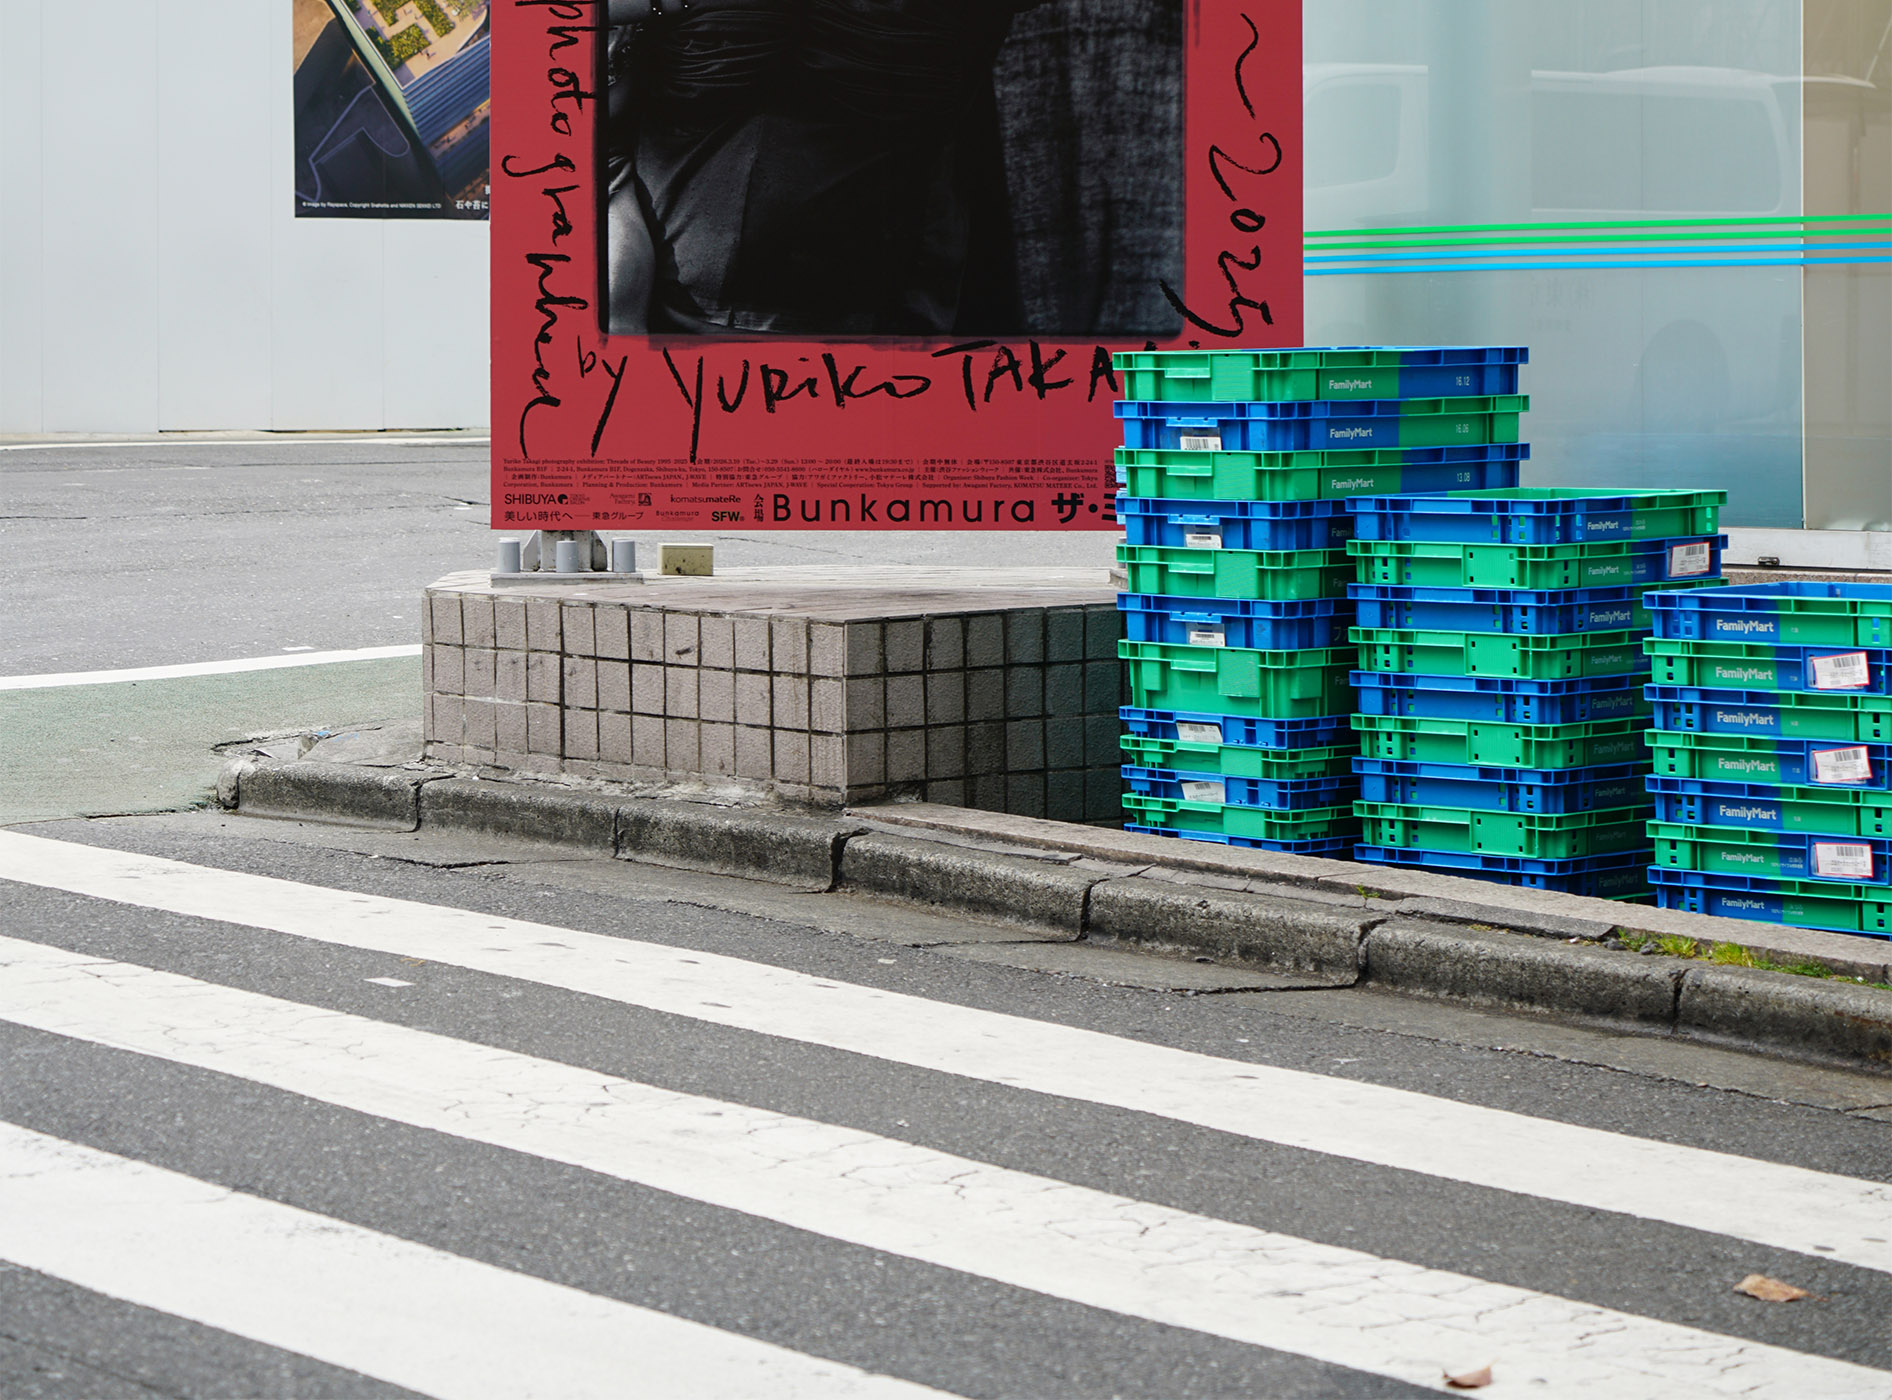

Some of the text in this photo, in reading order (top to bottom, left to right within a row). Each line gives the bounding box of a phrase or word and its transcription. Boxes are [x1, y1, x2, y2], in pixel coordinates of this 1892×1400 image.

[1329, 379, 1372, 391] FamilyMart
[577, 335, 628, 458] by
[1330, 428, 1373, 440] FamilyMart
[1332, 478, 1374, 491] FamilyMart
[504, 493, 557, 505] SHIBUYA
[773, 493, 1034, 522] Bunkamura
[504, 511, 645, 522] 美しい時代へ 東急グループ
[1587, 521, 1619, 531] FamilyMart
[1588, 566, 1619, 576] FamilyMart
[1590, 611, 1631, 624] FamilyMart
[1716, 619, 1774, 634] FamilyMart
[1591, 654, 1623, 665] FamilyMart
[1715, 666, 1773, 682] FamilyMart
[1592, 696, 1633, 710] FamilyMart
[1717, 711, 1774, 726] FamilyMart
[1593, 741, 1635, 754] FamilyMart
[1718, 757, 1776, 773] FamilyMart
[1719, 805, 1777, 821] FamilyMart
[1721, 852, 1764, 863] FamilyMart
[1598, 874, 1639, 888] FamilyMart
[1722, 898, 1765, 909] FamilyMart
